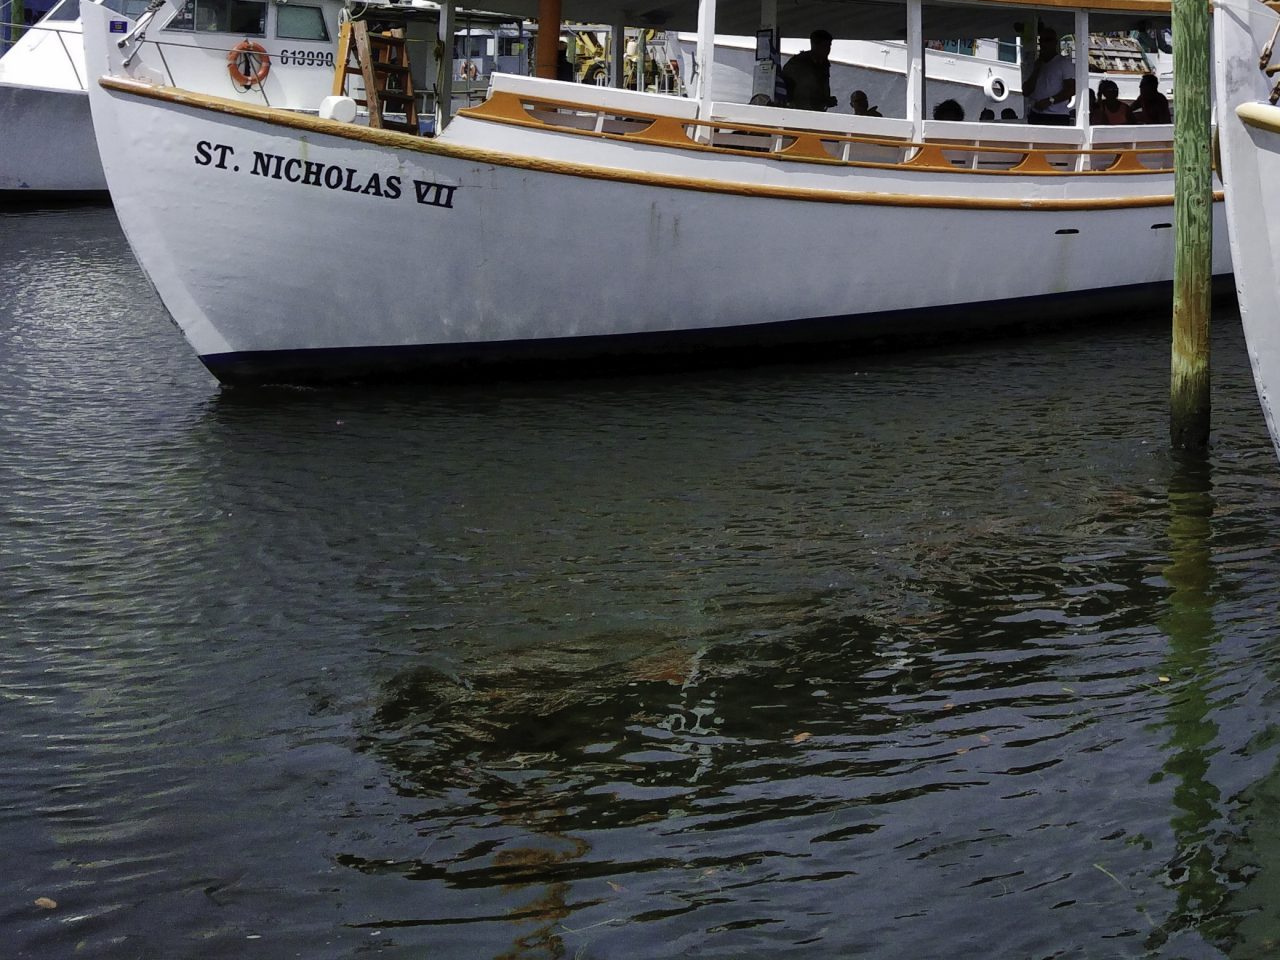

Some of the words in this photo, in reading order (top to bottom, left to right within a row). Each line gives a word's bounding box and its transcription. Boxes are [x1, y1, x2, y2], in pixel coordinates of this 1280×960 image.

[280, 49, 334, 67] 613990
[194, 140, 240, 172] ST.
[250, 151, 402, 199] NICHOLAS
[413, 179, 457, 209] VII
